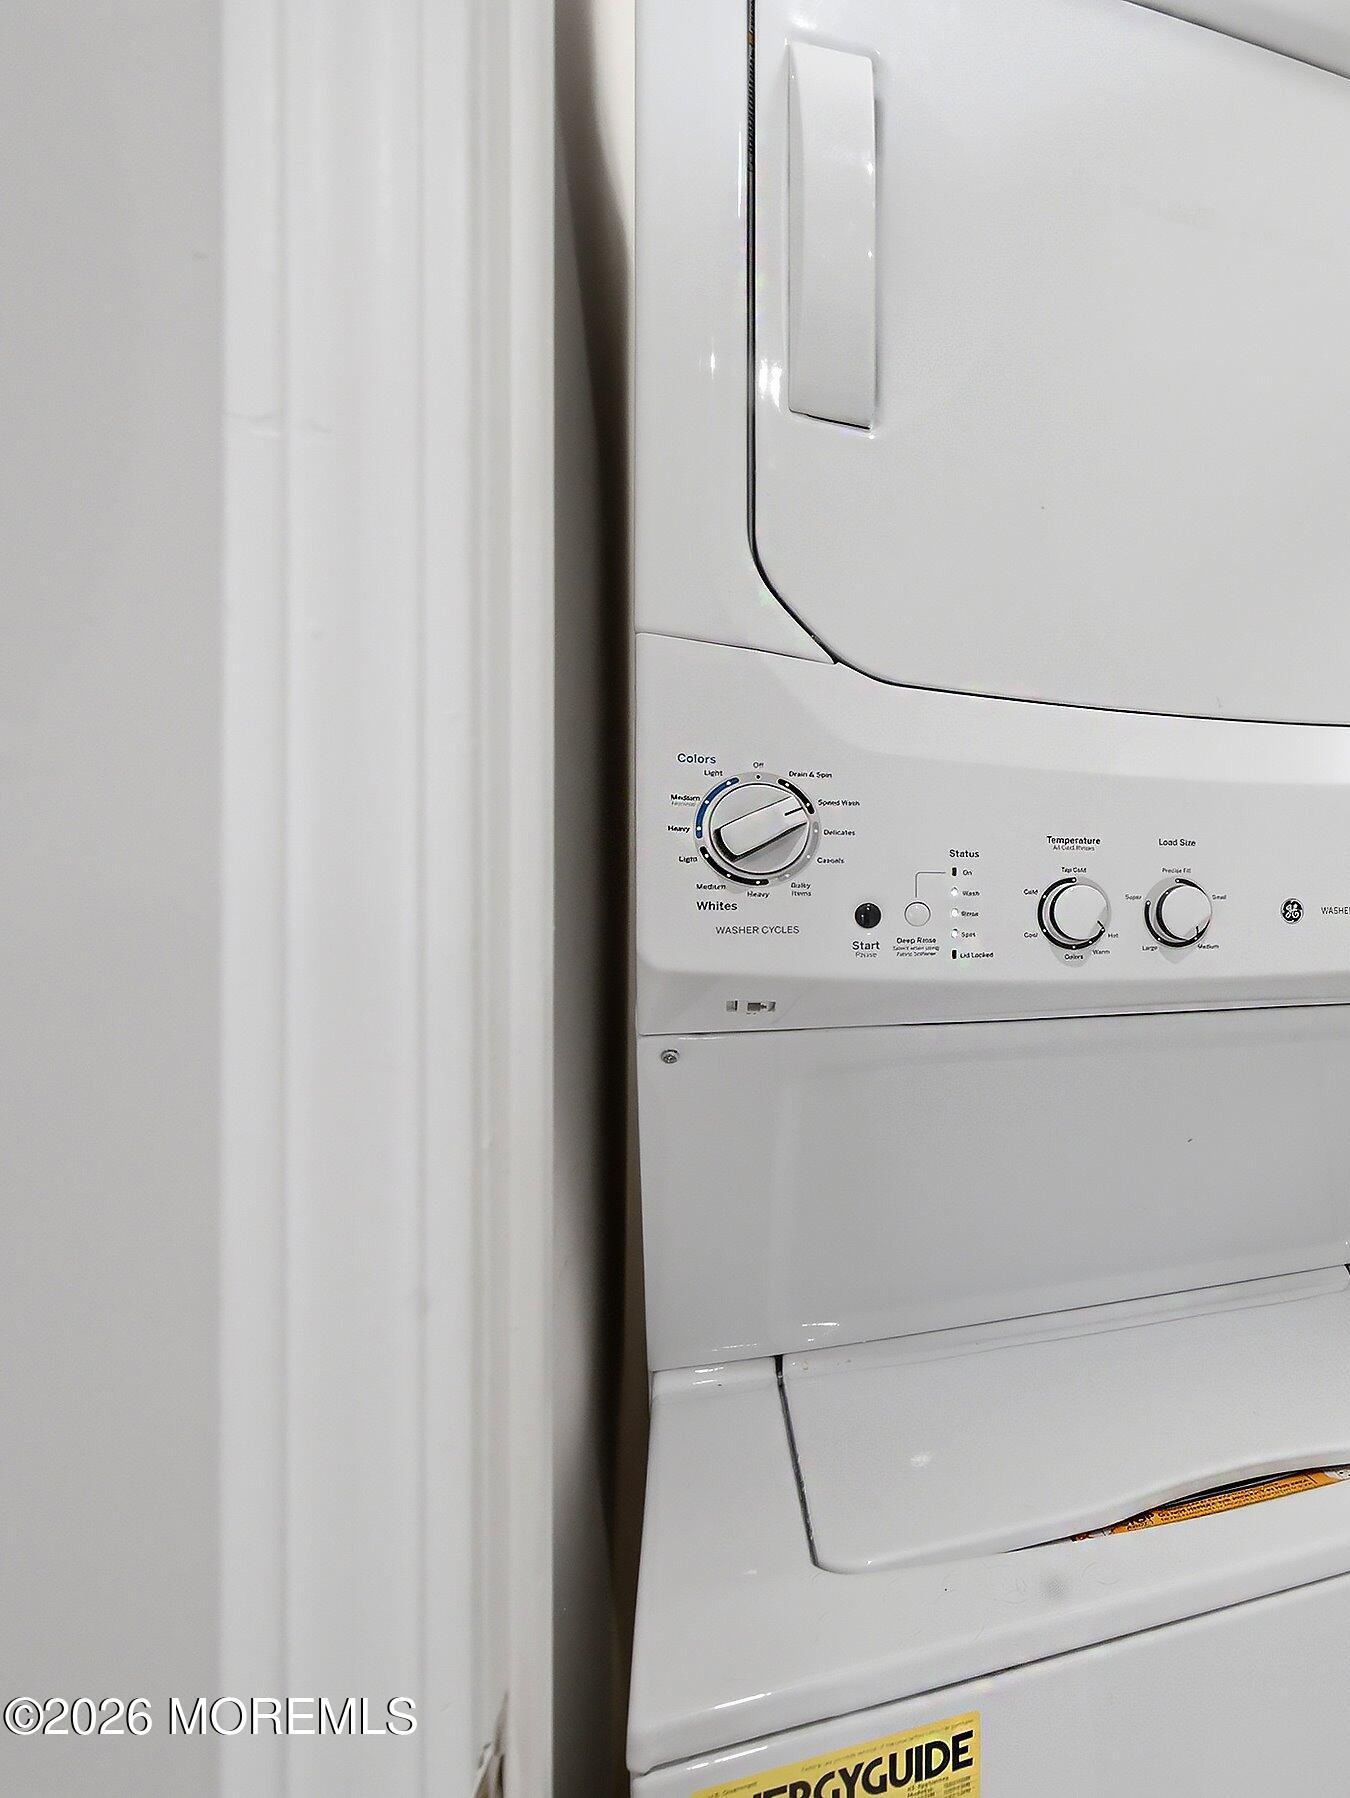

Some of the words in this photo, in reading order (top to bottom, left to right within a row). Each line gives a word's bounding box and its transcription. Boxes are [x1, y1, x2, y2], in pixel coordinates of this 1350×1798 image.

[677, 753, 717, 765] Colors
[753, 761, 765, 769] Off
[703, 769, 724, 778] Light
[788, 770, 808, 779] Drain
[670, 793, 701, 802] Medium
[667, 825, 691, 834] Heavy
[823, 829, 856, 837] Delicates
[1047, 836, 1101, 846] Temperature
[1158, 838, 1178, 847] Load
[1179, 838, 1196, 847] Size
[949, 848, 980, 858] Status
[678, 855, 698, 864] Light
[696, 883, 726, 891] Medium
[747, 890, 770, 899] Heavy
[696, 901, 738, 911] Whites
[715, 925, 760, 935] WASHER
[761, 925, 800, 935] CYCLES
[852, 941, 880, 951] Start
[855, 951, 878, 959] Pause
